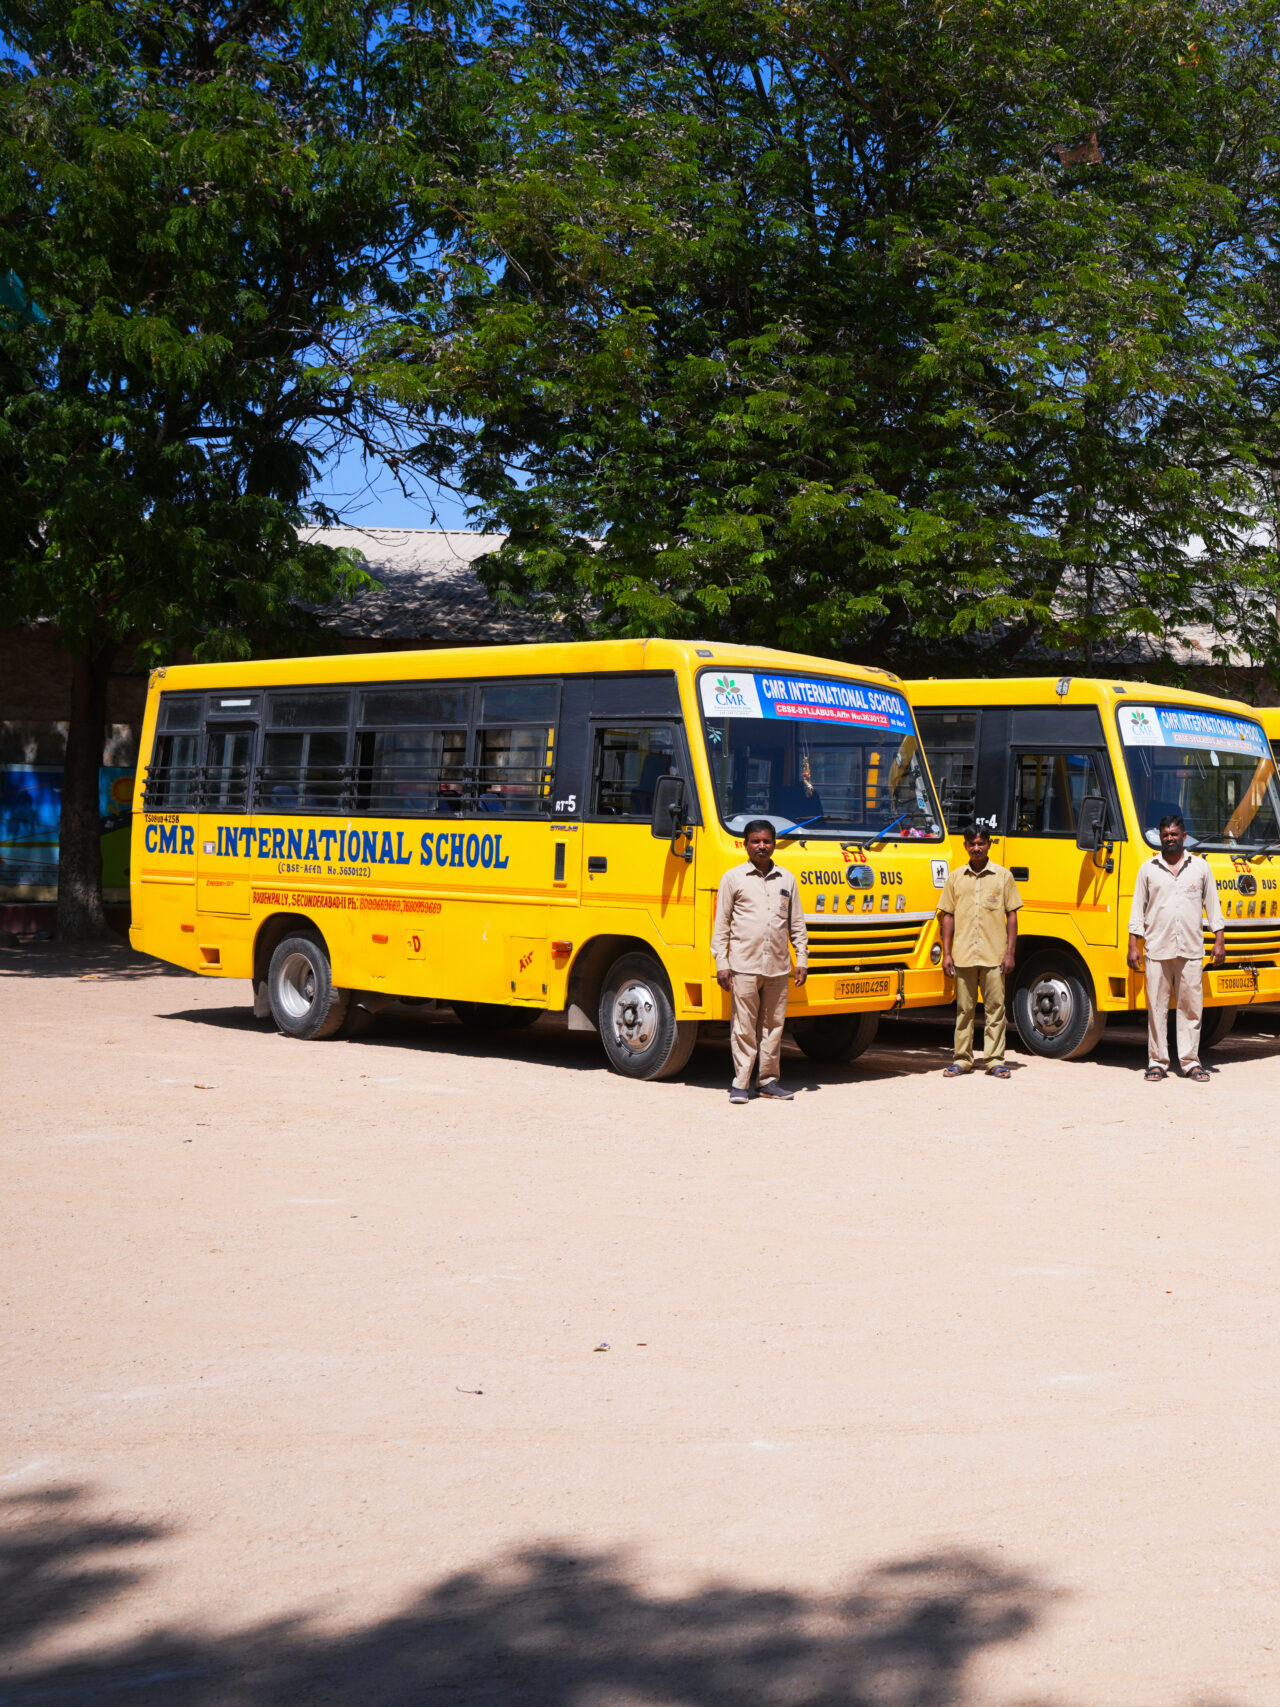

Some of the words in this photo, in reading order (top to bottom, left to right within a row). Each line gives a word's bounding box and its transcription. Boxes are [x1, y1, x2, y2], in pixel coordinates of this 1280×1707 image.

[716, 692, 747, 706] CMR
[762, 678, 789, 701] CMR
[787, 681, 868, 709] INTERNATIONAL
[867, 691, 904, 716] SCHOOL
[1160, 711, 1181, 729] CMR
[1179, 713, 1237, 737] INTERNATIONAL
[1236, 722, 1262, 743] SCHOOL
[555, 795, 576, 812] RT-5
[976, 814, 997, 829] RT-4
[145, 824, 195, 855] CMR
[216, 826, 412, 865] INTERNATIONAL
[420, 832, 509, 869] SCHOOL
[800, 871, 846, 885] SCHOOL
[880, 871, 903, 885] BUS
[1216, 879, 1238, 891] HOOL
[1262, 879, 1277, 890] BUS
[815, 894, 907, 912] EICHER
[1221, 900, 1278, 916] ICHER
[412, 935, 421, 952] D
[519, 951, 533, 973] Air
[840, 980, 889, 995] TS08UD4258
[1221, 977, 1255, 990] TS08UD425
